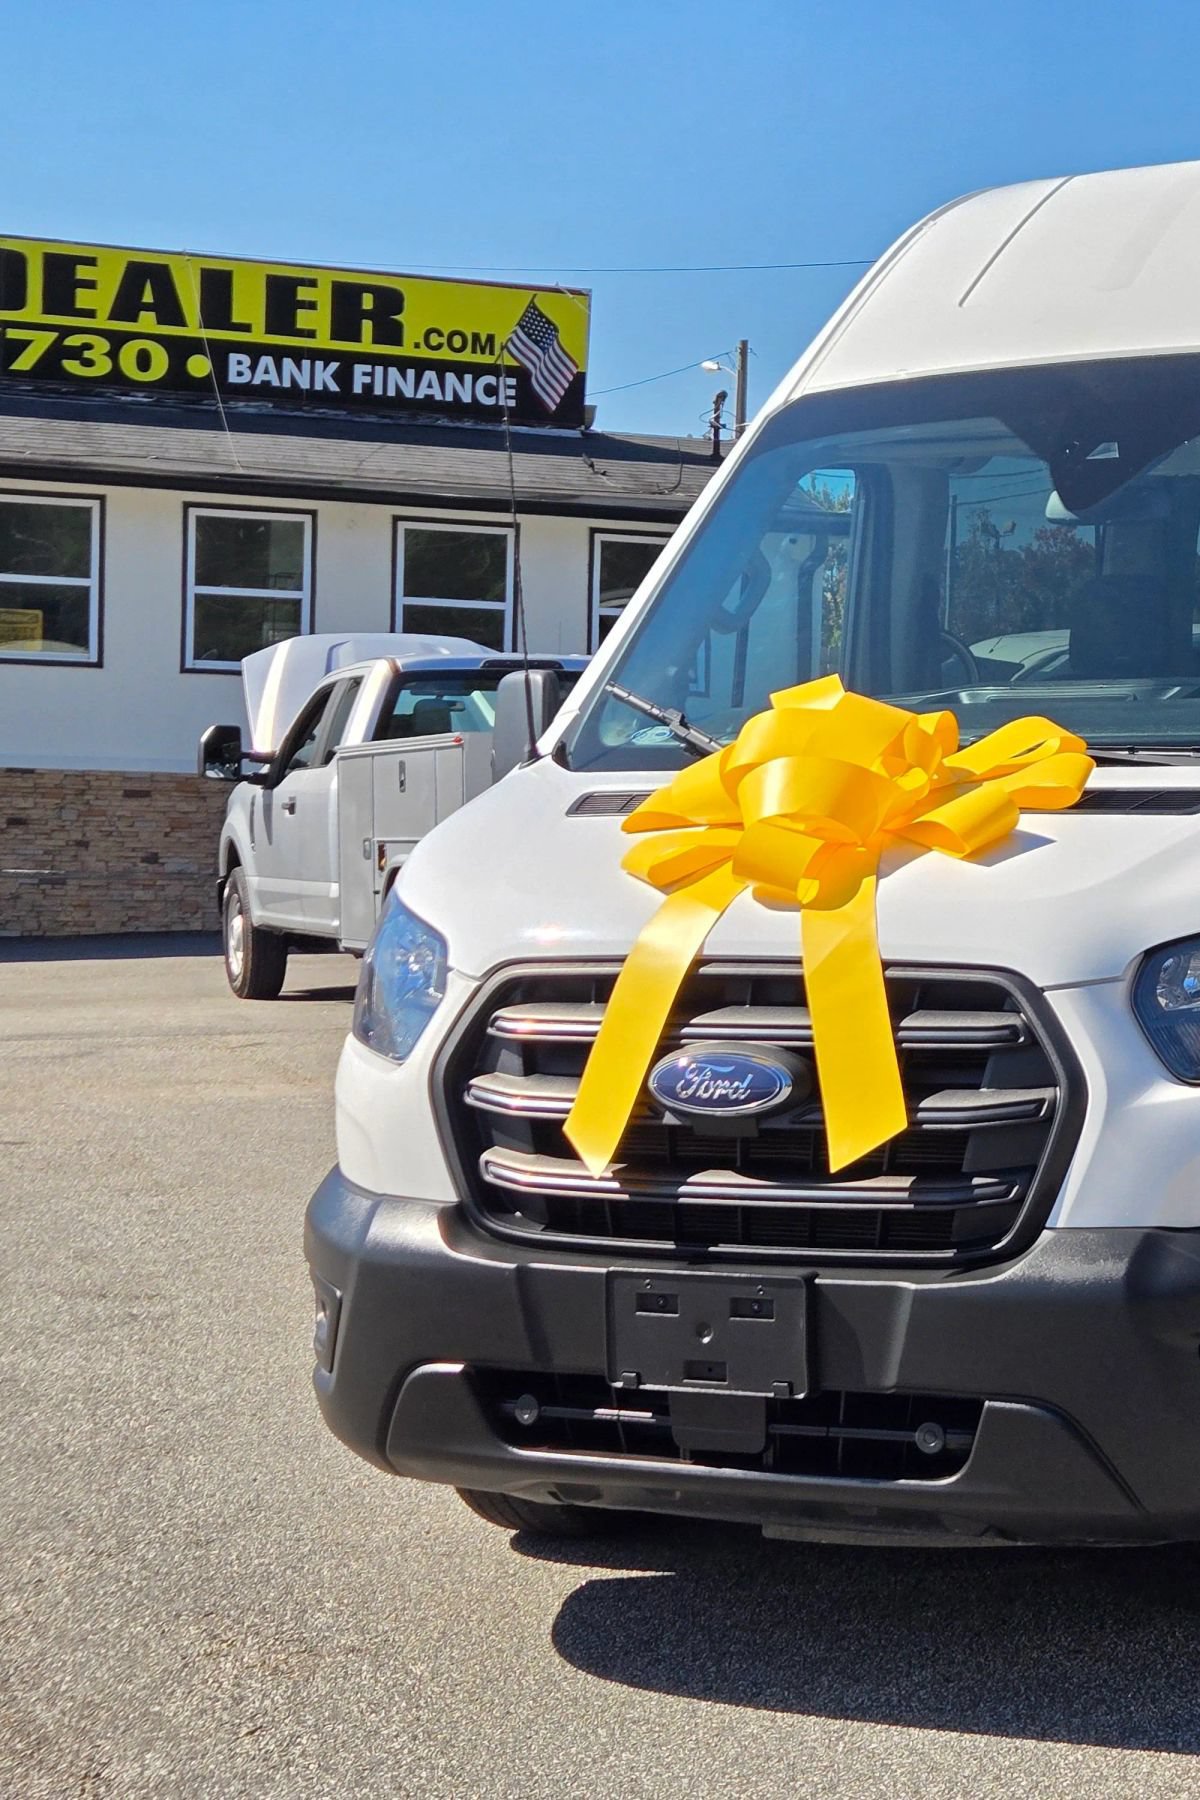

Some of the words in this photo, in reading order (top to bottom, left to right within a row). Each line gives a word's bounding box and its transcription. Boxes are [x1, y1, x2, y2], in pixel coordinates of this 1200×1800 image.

[413, 326, 496, 356] .COM
[227, 352, 341, 392] BANK
[353, 363, 517, 407] FINANCE
[675, 1062, 754, 1100] Ford
